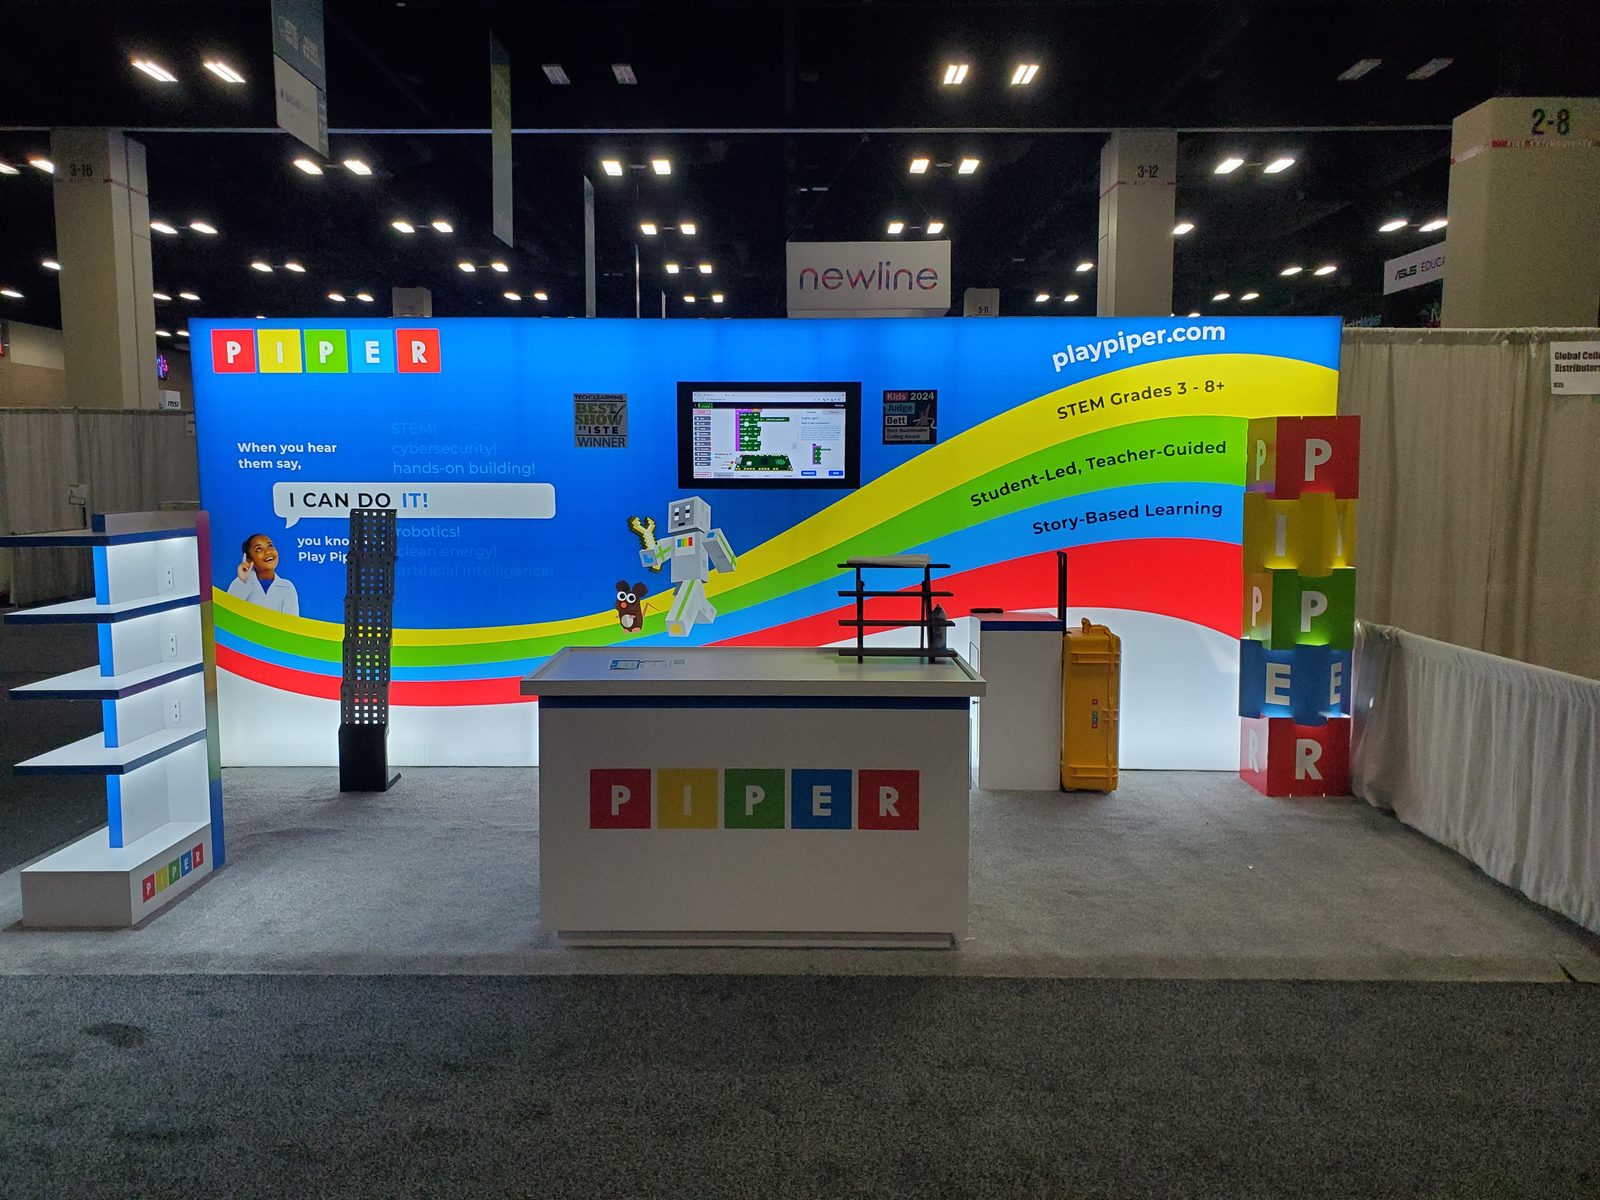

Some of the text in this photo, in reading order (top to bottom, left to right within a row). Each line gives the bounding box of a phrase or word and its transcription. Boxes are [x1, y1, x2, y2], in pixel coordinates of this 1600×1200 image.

[1531, 108, 1570, 135] 2-8
[1137, 165, 1159, 178] 3-12
[799, 261, 939, 290] newline
[1395, 265, 1418, 280] ASUS
[226, 340, 428, 364] PIPER
[1051, 322, 1226, 372] playpiper.com
[1554, 351, 1581, 360] Global
[887, 392, 935, 401] Kids 2024
[1056, 396, 1106, 420] STEM
[1110, 384, 1173, 406] Grades
[1177, 381, 1187, 396] 3
[1204, 379, 1225, 393] 8+
[575, 403, 618, 414] BEST
[886, 404, 913, 413] Judge
[575, 414, 624, 426] SHOW
[887, 416, 906, 424] Bett
[391, 422, 437, 435] STEM!
[588, 426, 619, 434] ISTE
[237, 442, 337, 455] When you hear
[577, 436, 626, 448] WINNER
[391, 442, 497, 457] cybersecurity!
[238, 458, 302, 471] them say,
[393, 461, 536, 477] hands-on building!
[969, 440, 1227, 508] Student-Led, Teacher-Guided
[289, 492, 428, 508] I CAN DO IT!
[1032, 501, 1223, 536] Story-Based Learning
[396, 525, 461, 538] robotics!
[297, 535, 350, 548] you kno
[298, 551, 348, 563] Play Pip
[396, 545, 497, 560] clean energy!
[397, 563, 554, 579] artificial intelligence!
[610, 785, 900, 818] PIPER
[146, 851, 201, 896] PIPER
